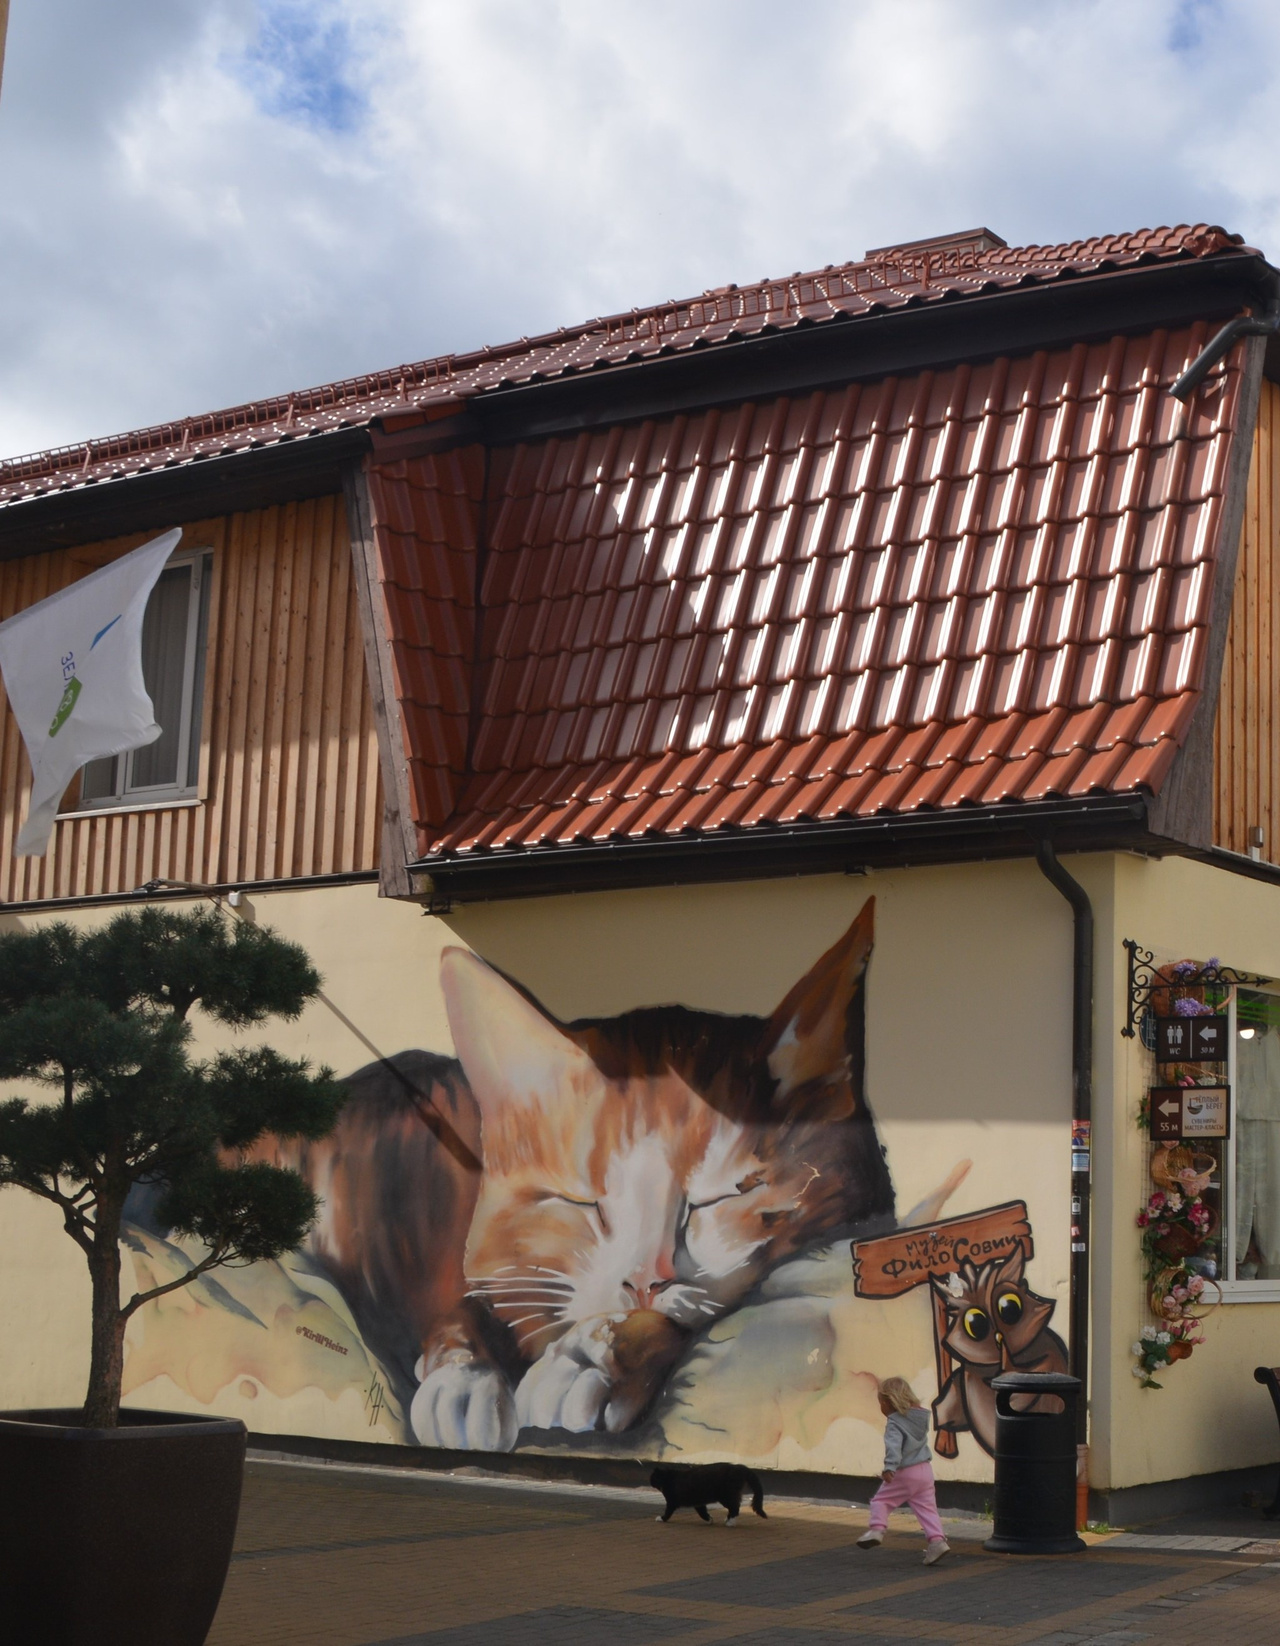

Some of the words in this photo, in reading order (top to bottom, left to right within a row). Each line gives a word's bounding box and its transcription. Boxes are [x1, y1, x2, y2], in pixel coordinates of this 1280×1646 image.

[1169, 1047, 1181, 1055] WC
[1200, 1046, 1208, 1054] 50
[1205, 1102, 1223, 1110] БЕРЕГ
[1160, 1122, 1170, 1132] 55
